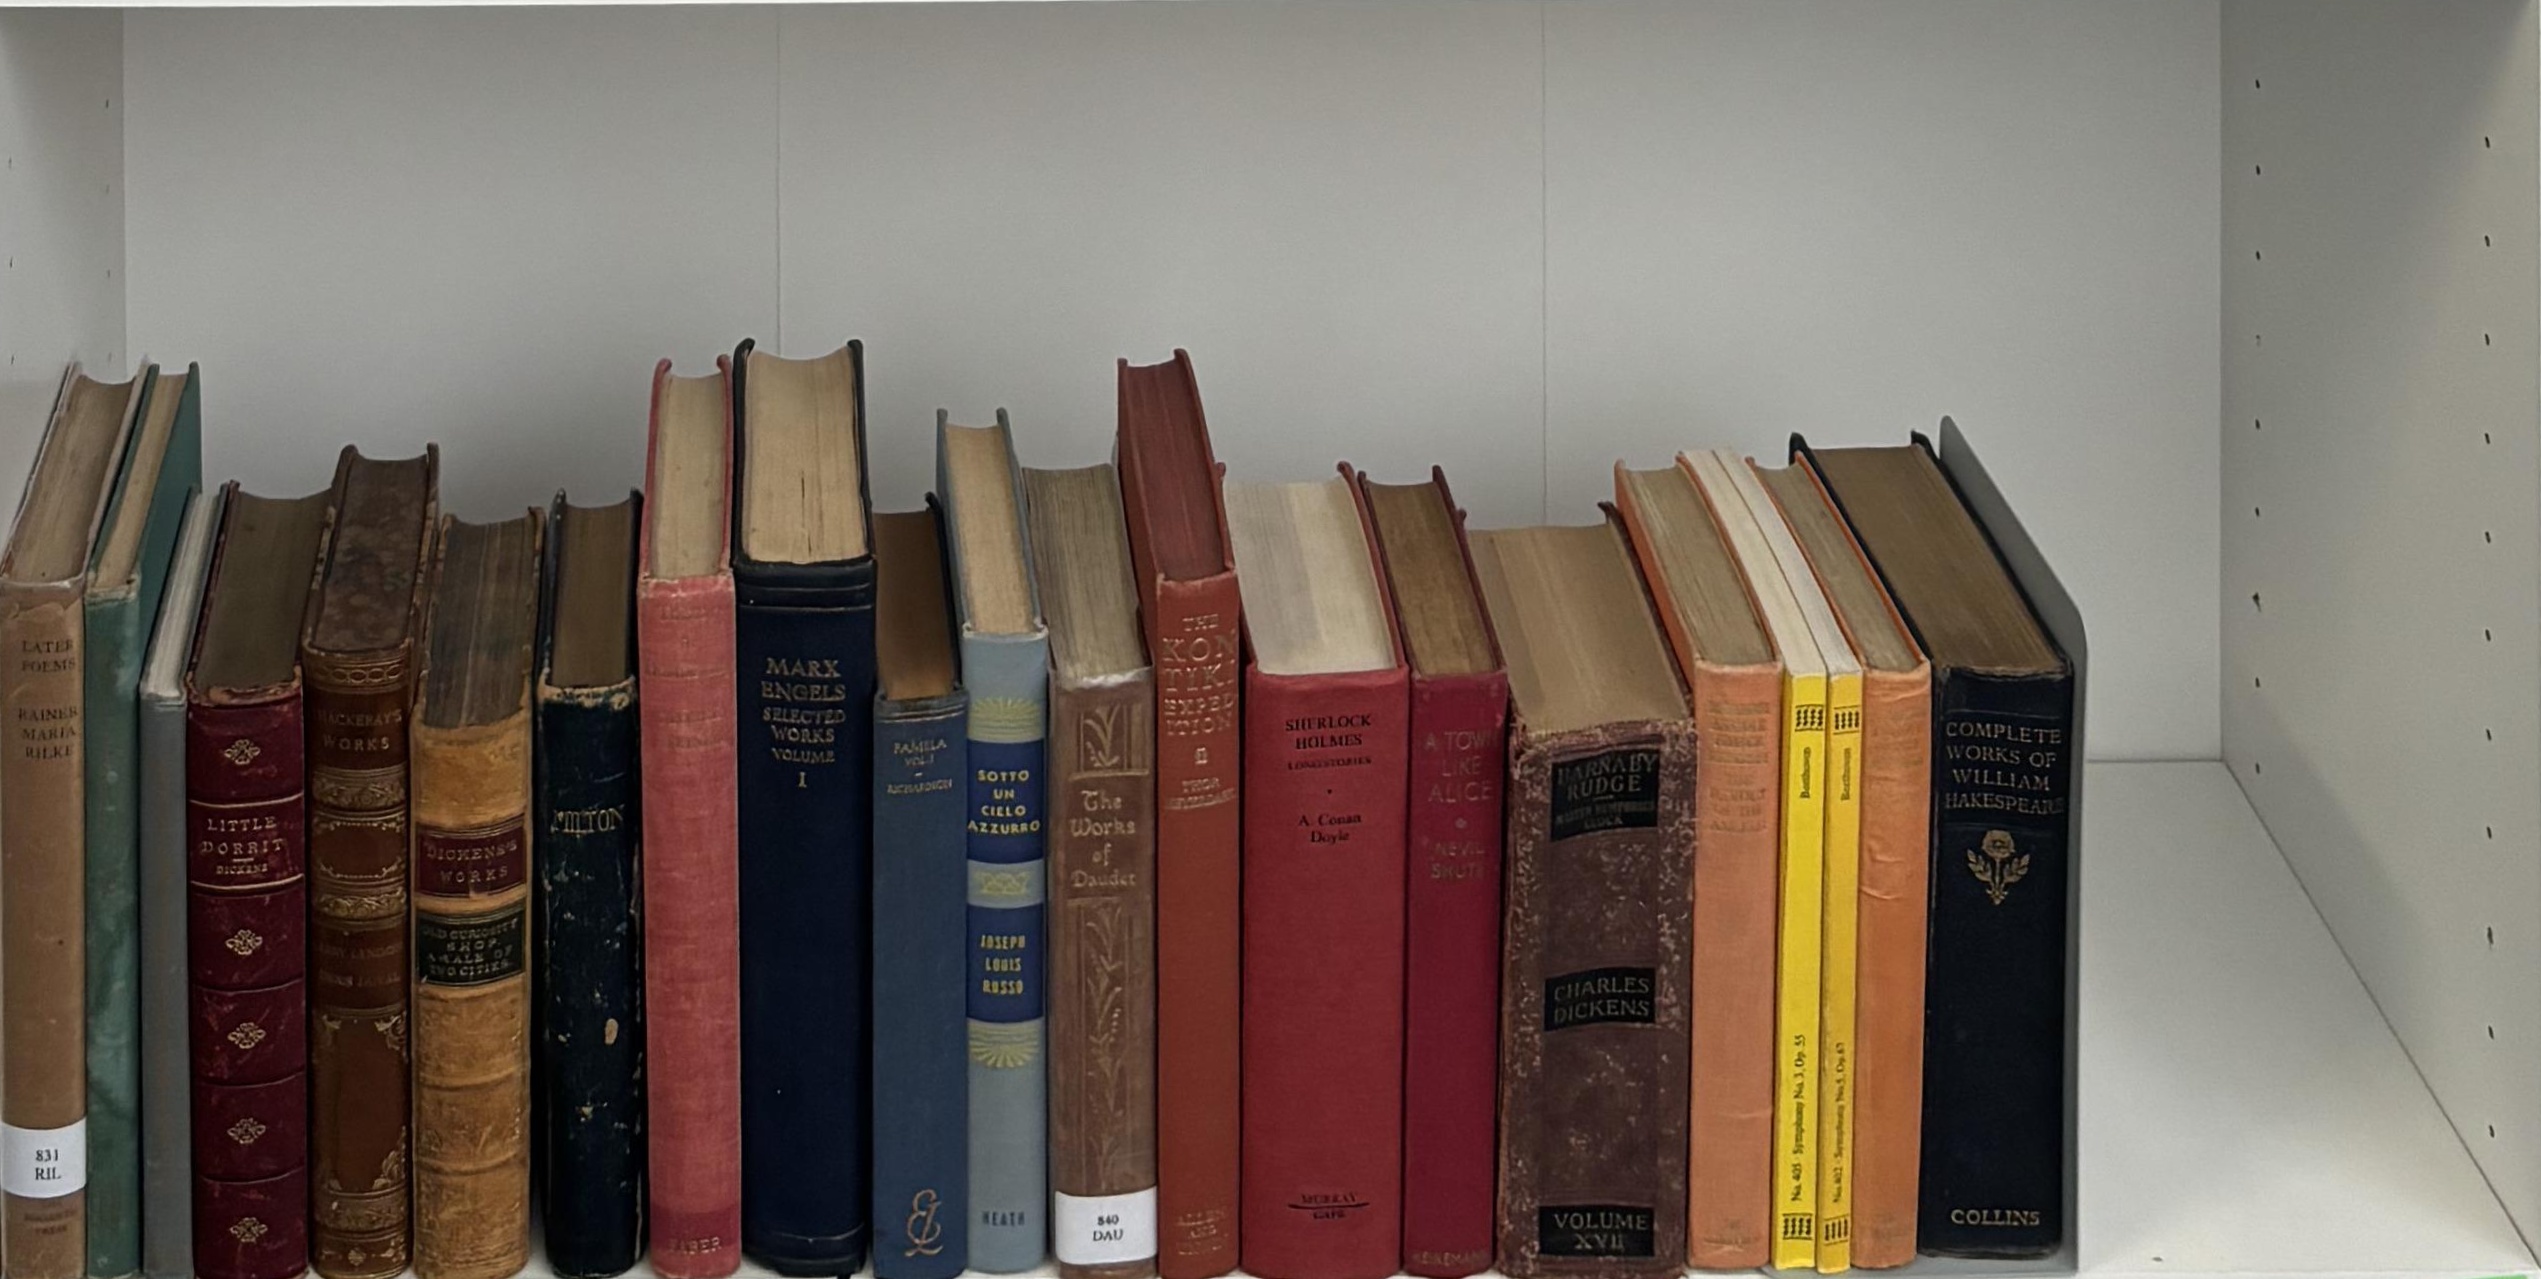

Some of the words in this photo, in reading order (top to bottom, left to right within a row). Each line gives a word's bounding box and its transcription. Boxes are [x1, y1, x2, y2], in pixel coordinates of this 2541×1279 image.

[1182, 613, 1219, 632] THE
[22, 640, 74, 654] LATER
[1162, 630, 1236, 662] KON
[21, 660, 76, 672] POEMS
[766, 657, 841, 678] MARX
[1163, 659, 1236, 692] TIKI
[760, 680, 846, 702] ENGELS
[18, 706, 79, 721] RAINER
[762, 706, 846, 725] SELECTED
[1285, 714, 1372, 731] SHERLOCK
[22, 726, 77, 740] MARIA
[770, 724, 835, 743] WORKS
[1946, 721, 2062, 745] COMPLETE
[322, 735, 390, 752] WORKS
[1296, 734, 1363, 750] HOLMES
[1425, 734, 1437, 750] A
[25, 745, 73, 760] RILKE
[770, 747, 836, 764] VOLUME
[1945, 744, 2020, 765] WORKS
[2029, 751, 2057, 769] OF
[1442, 755, 1483, 777] LIKE
[1557, 752, 1658, 785] BARNABY
[977, 769, 1030, 783] SOTTO
[1952, 768, 2050, 792] WILLIAM
[992, 788, 1016, 800] UN
[1427, 780, 1494, 803] ALICE
[1567, 774, 1642, 801] RUDGE
[1081, 790, 1123, 811] The
[980, 804, 1027, 818] CIELO
[1318, 813, 1362, 826] Conan
[207, 816, 277, 832] LITTLE
[966, 819, 1041, 835] AZZURRO
[1069, 818, 1136, 837] Works
[1310, 830, 1350, 845] Doyle
[200, 838, 284, 855] DORRIT
[1091, 842, 1112, 866] of
[215, 863, 269, 875] DICKENS
[440, 866, 508, 883] WORKS
[1070, 867, 1136, 888] Daudet
[980, 934, 1027, 950] JOSEPH
[985, 957, 1022, 973] LOUIS
[982, 979, 1024, 995] RUSSO
[1553, 975, 1651, 1003] CHARLES
[1553, 999, 1651, 1025] DICKENS
[1792, 1101, 1805, 1155] Symphony
[35, 1149, 59, 1162] 831
[35, 1166, 62, 1181] RIL
[982, 1210, 1025, 1226] HEATH
[1097, 1214, 1120, 1226] 840
[1554, 1212, 1648, 1231] VOLUME
[1950, 1208, 2041, 1226] COLLINS
[1093, 1229, 1124, 1242] DAU
[1574, 1233, 1624, 1250] XVII
